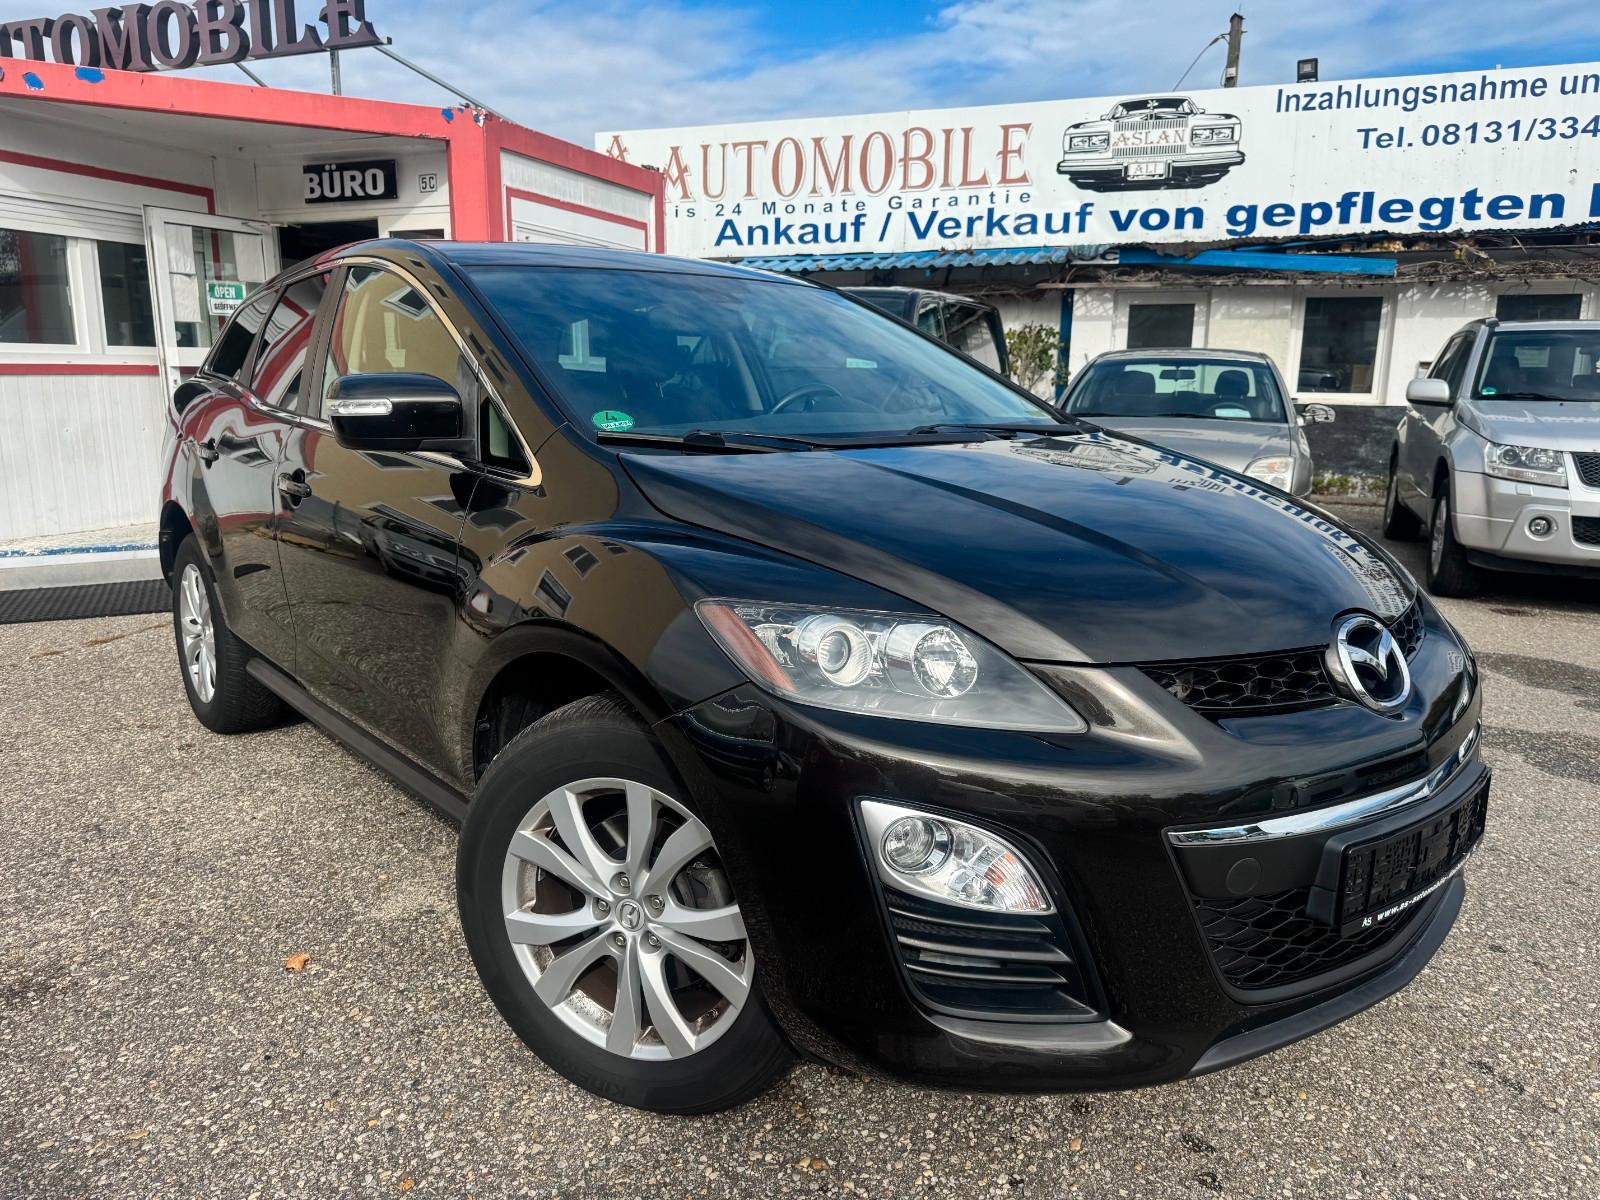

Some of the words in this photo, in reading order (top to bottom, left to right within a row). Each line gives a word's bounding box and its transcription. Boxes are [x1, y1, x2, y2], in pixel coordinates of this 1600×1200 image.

[0, 0, 382, 72] TOMOBILE
[1276, 76, 1548, 112] Inzahlungsnahme
[1560, 74, 1600, 95] un
[1113, 129, 1185, 146] ASLAN
[664, 123, 1032, 201] AUTOMOBILE
[1134, 164, 1158, 174] ALI
[303, 164, 385, 199] BÜRO
[675, 205, 696, 218] is
[715, 202, 742, 217] 24
[762, 199, 866, 215] Monate
[888, 190, 1032, 210] Garantie
[714, 214, 867, 246] Ankauf
[907, 203, 1095, 240] Verkauf
[1109, 206, 1204, 232] von
[1226, 188, 1566, 237] gepflegten
[214, 286, 236, 298] OPEN
